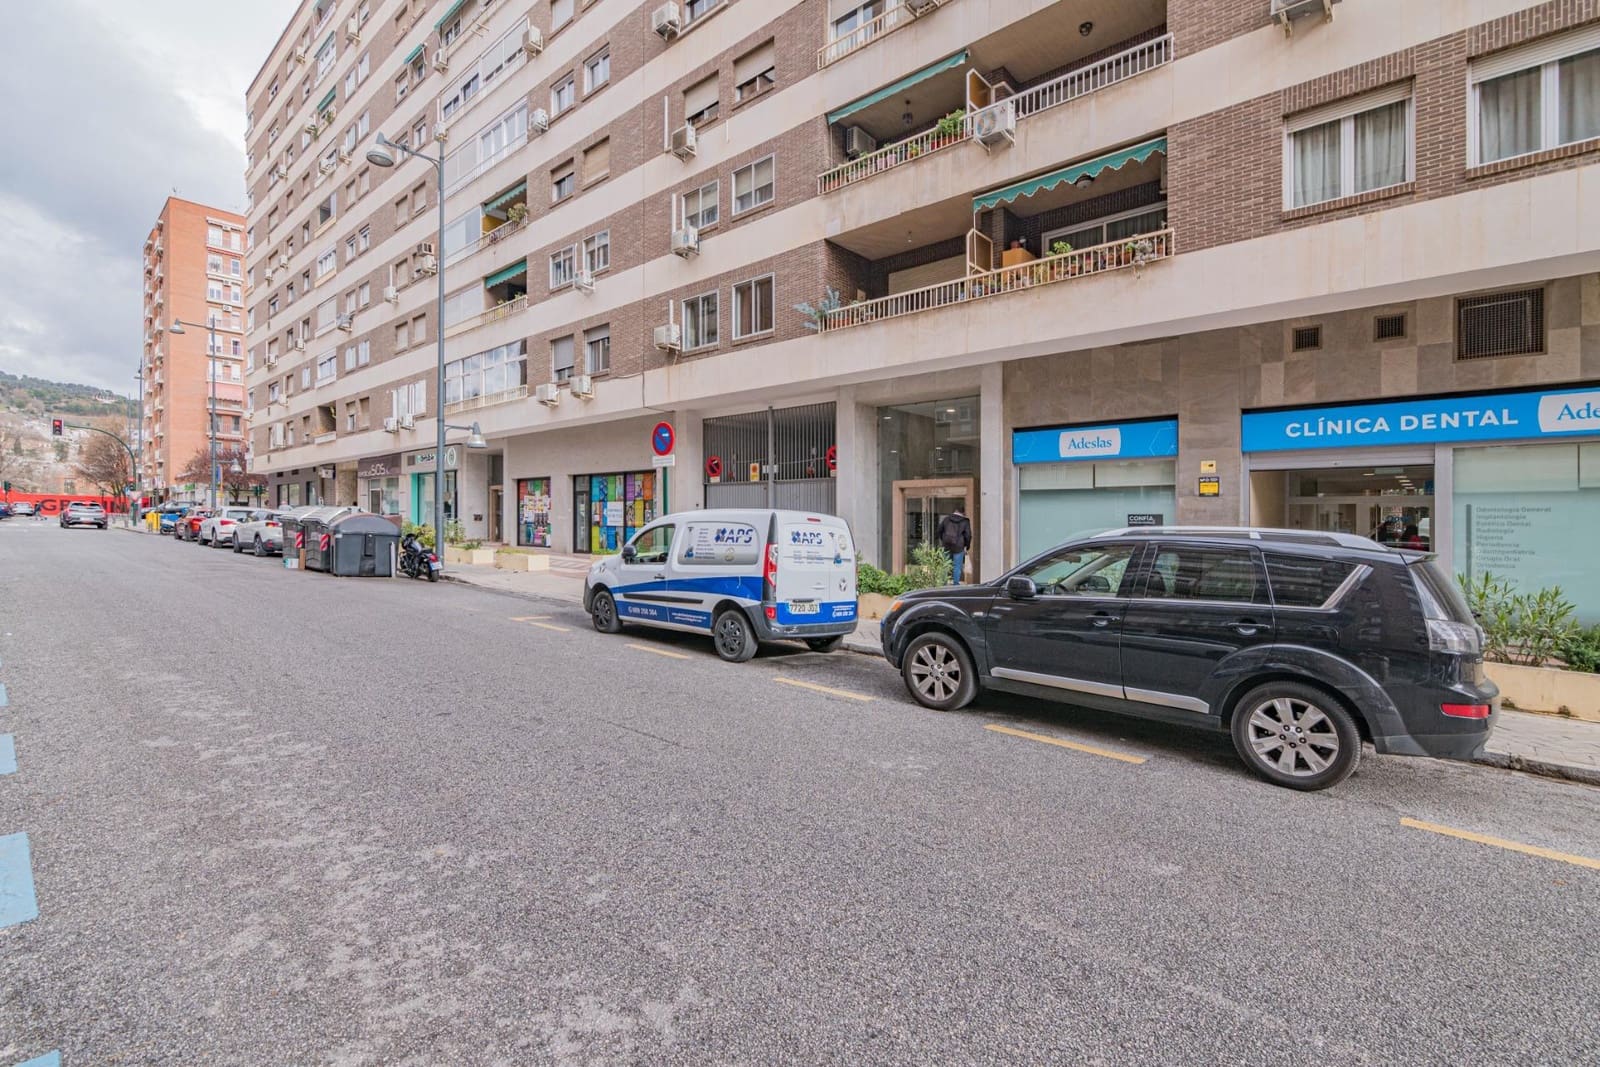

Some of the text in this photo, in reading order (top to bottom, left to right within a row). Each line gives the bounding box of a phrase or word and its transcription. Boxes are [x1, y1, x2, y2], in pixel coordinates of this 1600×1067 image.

[1285, 408, 1519, 438] CLÍNICA DENTAL
[1068, 436, 1112, 449] Adeslas
[725, 528, 753, 543] APS
[802, 532, 822, 544] APS
